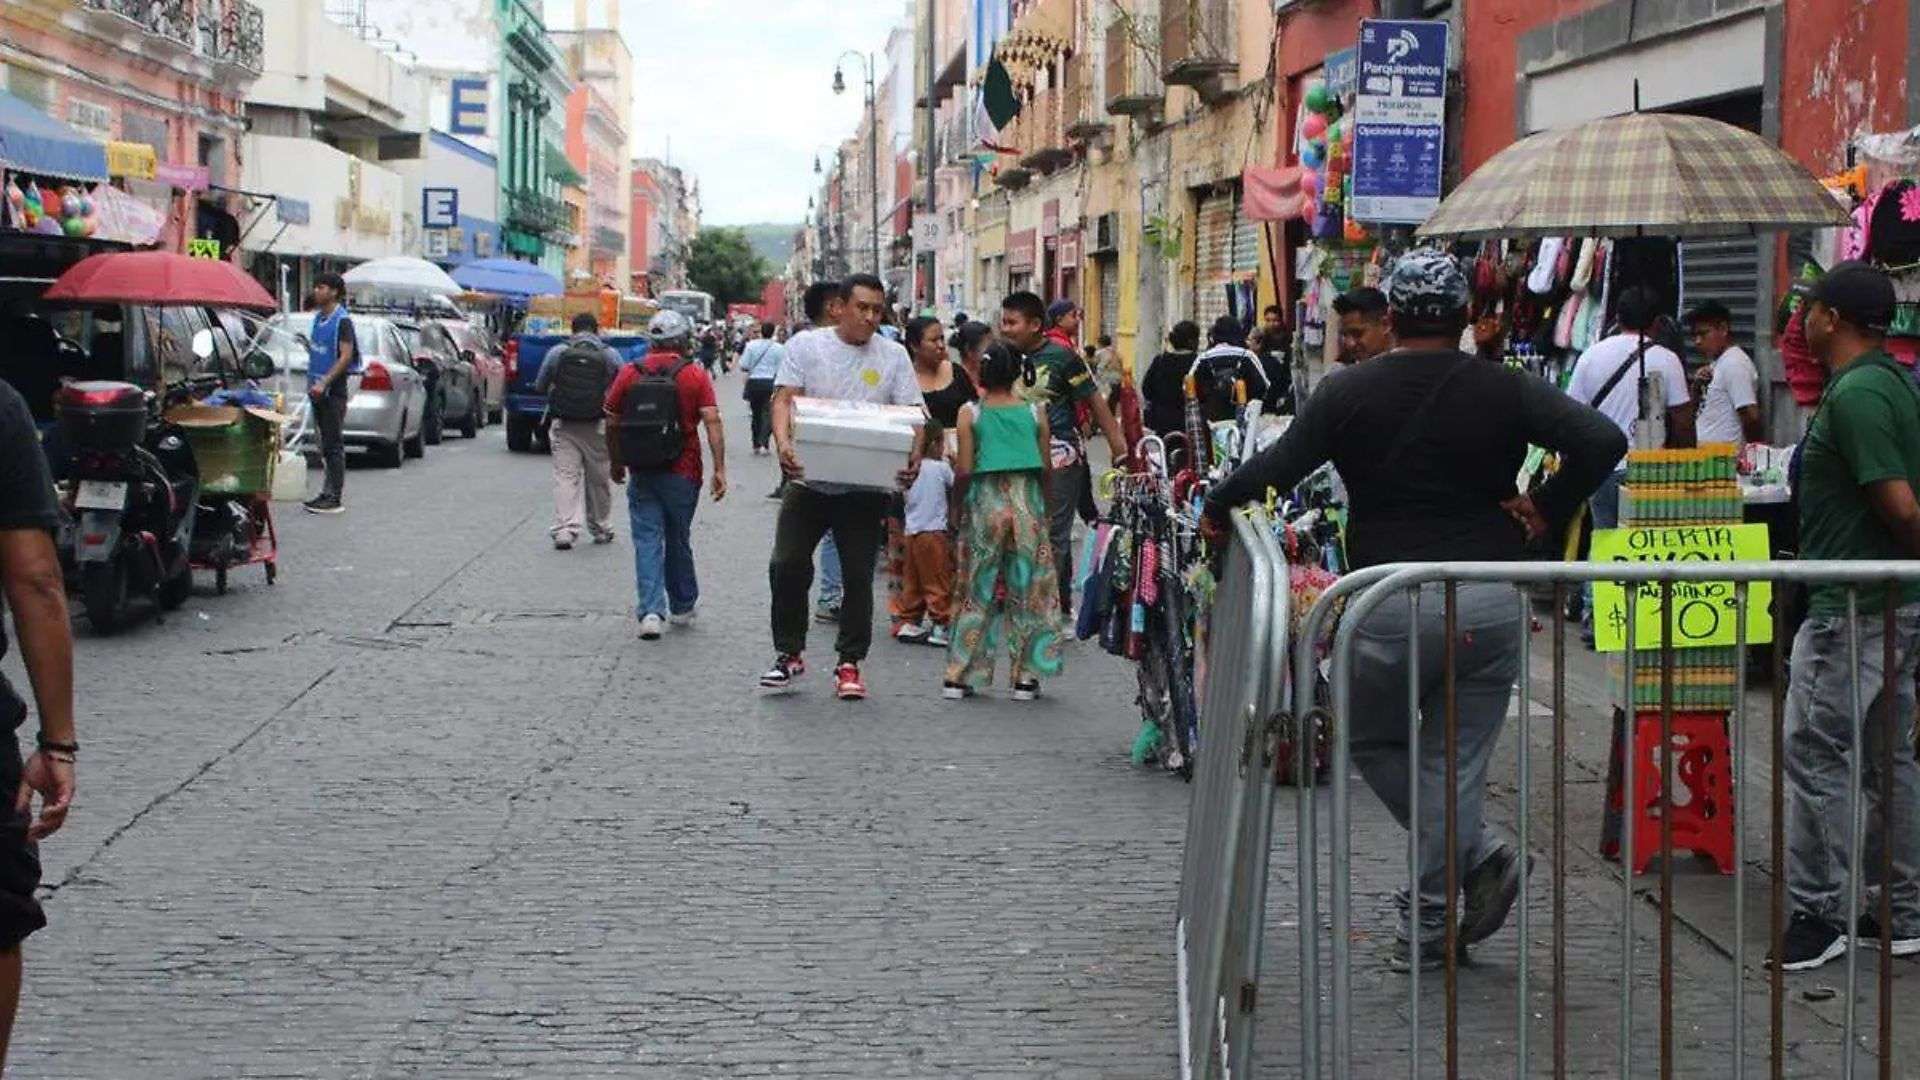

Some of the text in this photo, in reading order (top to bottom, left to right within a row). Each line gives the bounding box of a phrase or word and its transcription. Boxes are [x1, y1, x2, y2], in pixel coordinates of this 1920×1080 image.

[452, 80, 488, 134] E
[1402, 127, 1415, 135] de
[1416, 128, 1440, 138] pago
[1629, 527, 1734, 550] OFERTA
